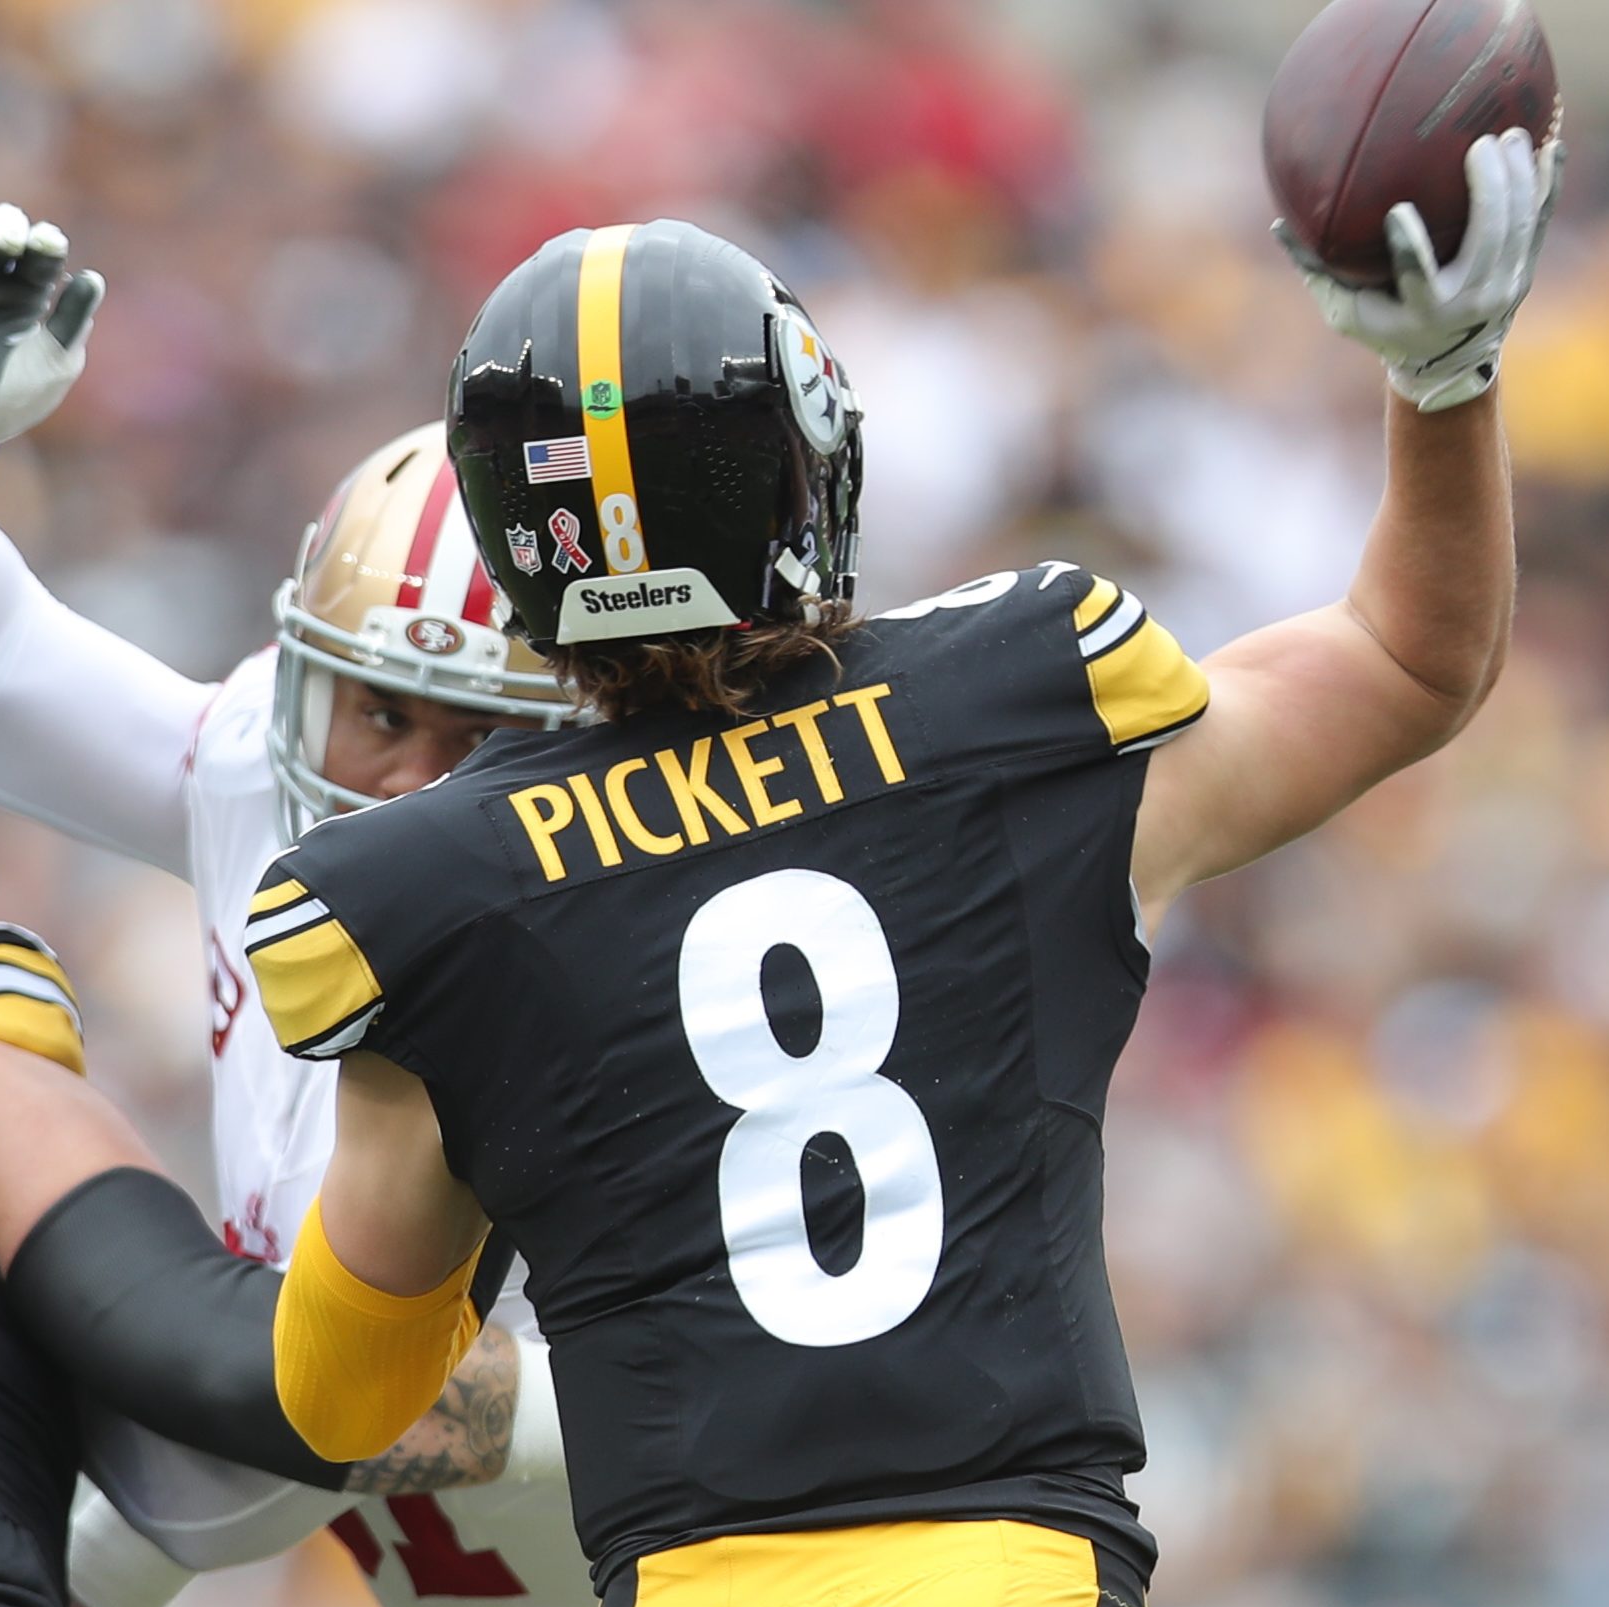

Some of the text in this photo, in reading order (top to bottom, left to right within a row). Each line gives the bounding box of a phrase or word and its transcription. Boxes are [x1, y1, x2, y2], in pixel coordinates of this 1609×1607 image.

[579, 582, 692, 614] Steelers
[600, 492, 646, 573] 8
[508, 682, 906, 882] PICKETT
[678, 867, 945, 1347] 8
